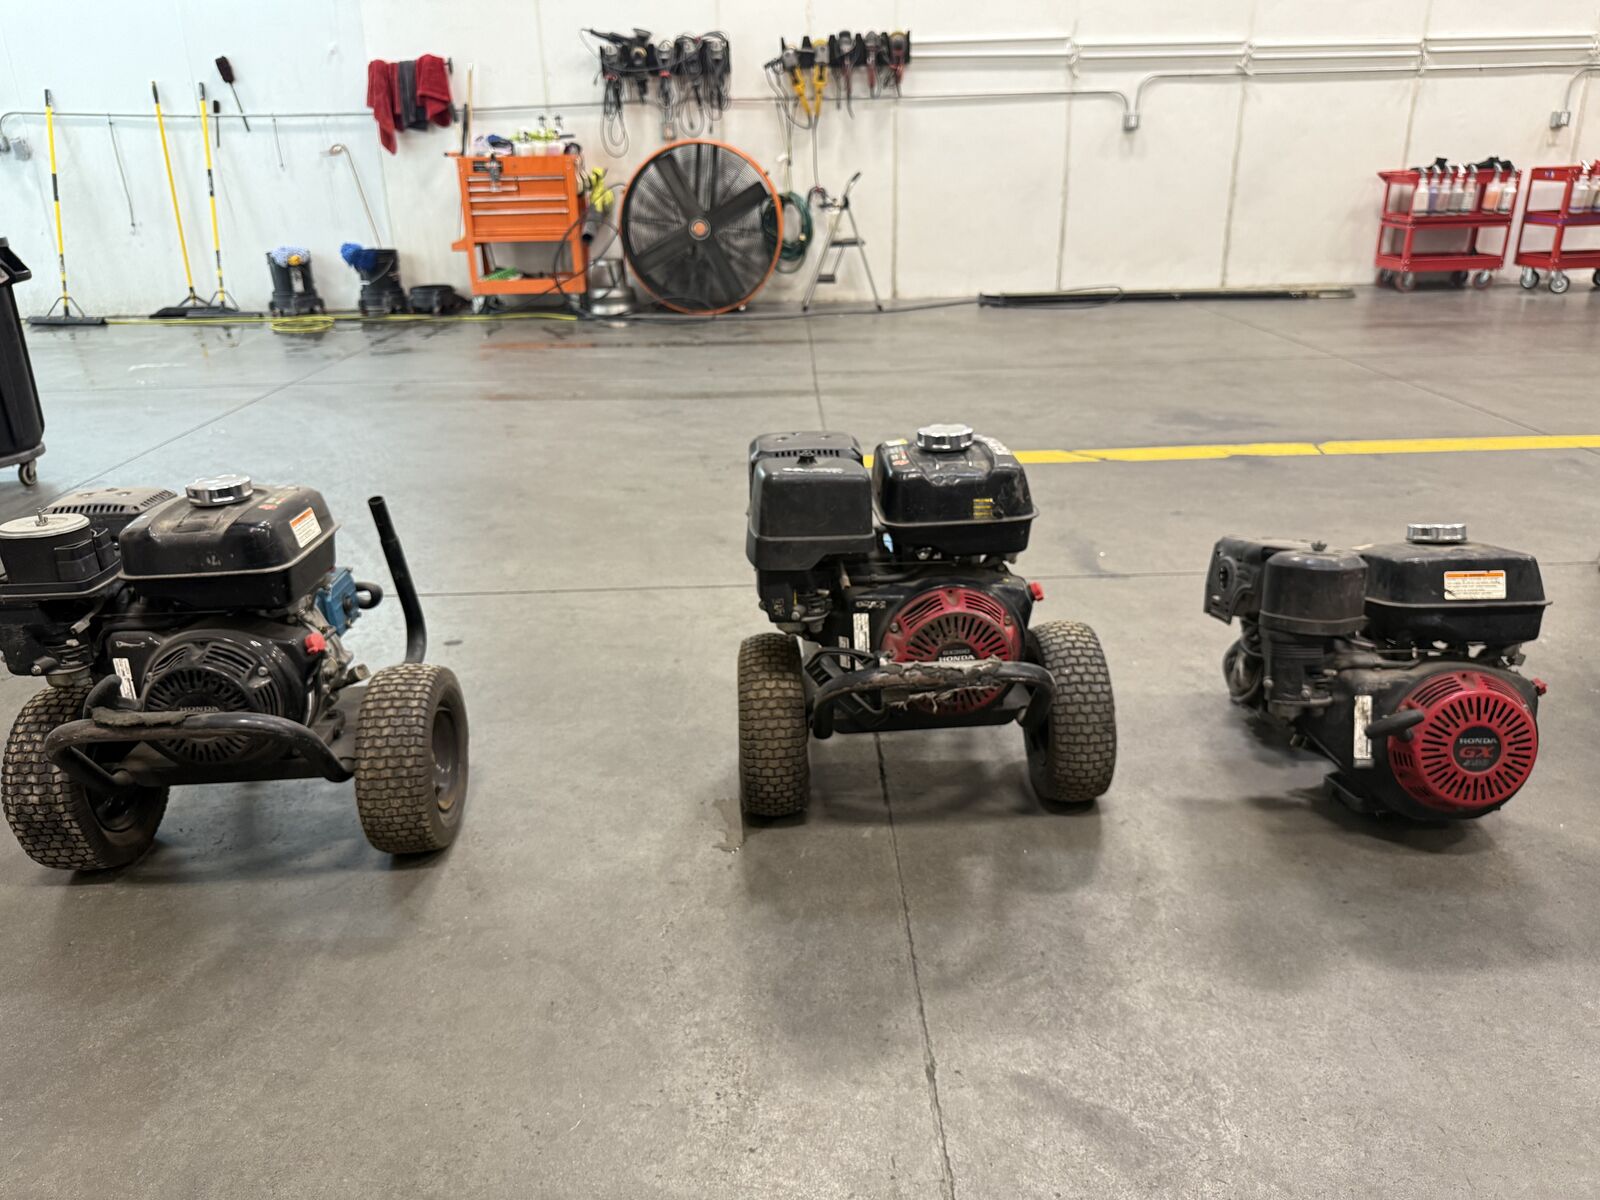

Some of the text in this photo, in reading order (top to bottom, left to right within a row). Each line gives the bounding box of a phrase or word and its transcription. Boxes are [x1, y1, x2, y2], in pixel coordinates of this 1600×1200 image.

[938, 654, 976, 662] HONDA
[180, 705, 220, 713] HONDA
[1459, 737, 1498, 745] HONDA
[1459, 745, 1495, 758] GX
